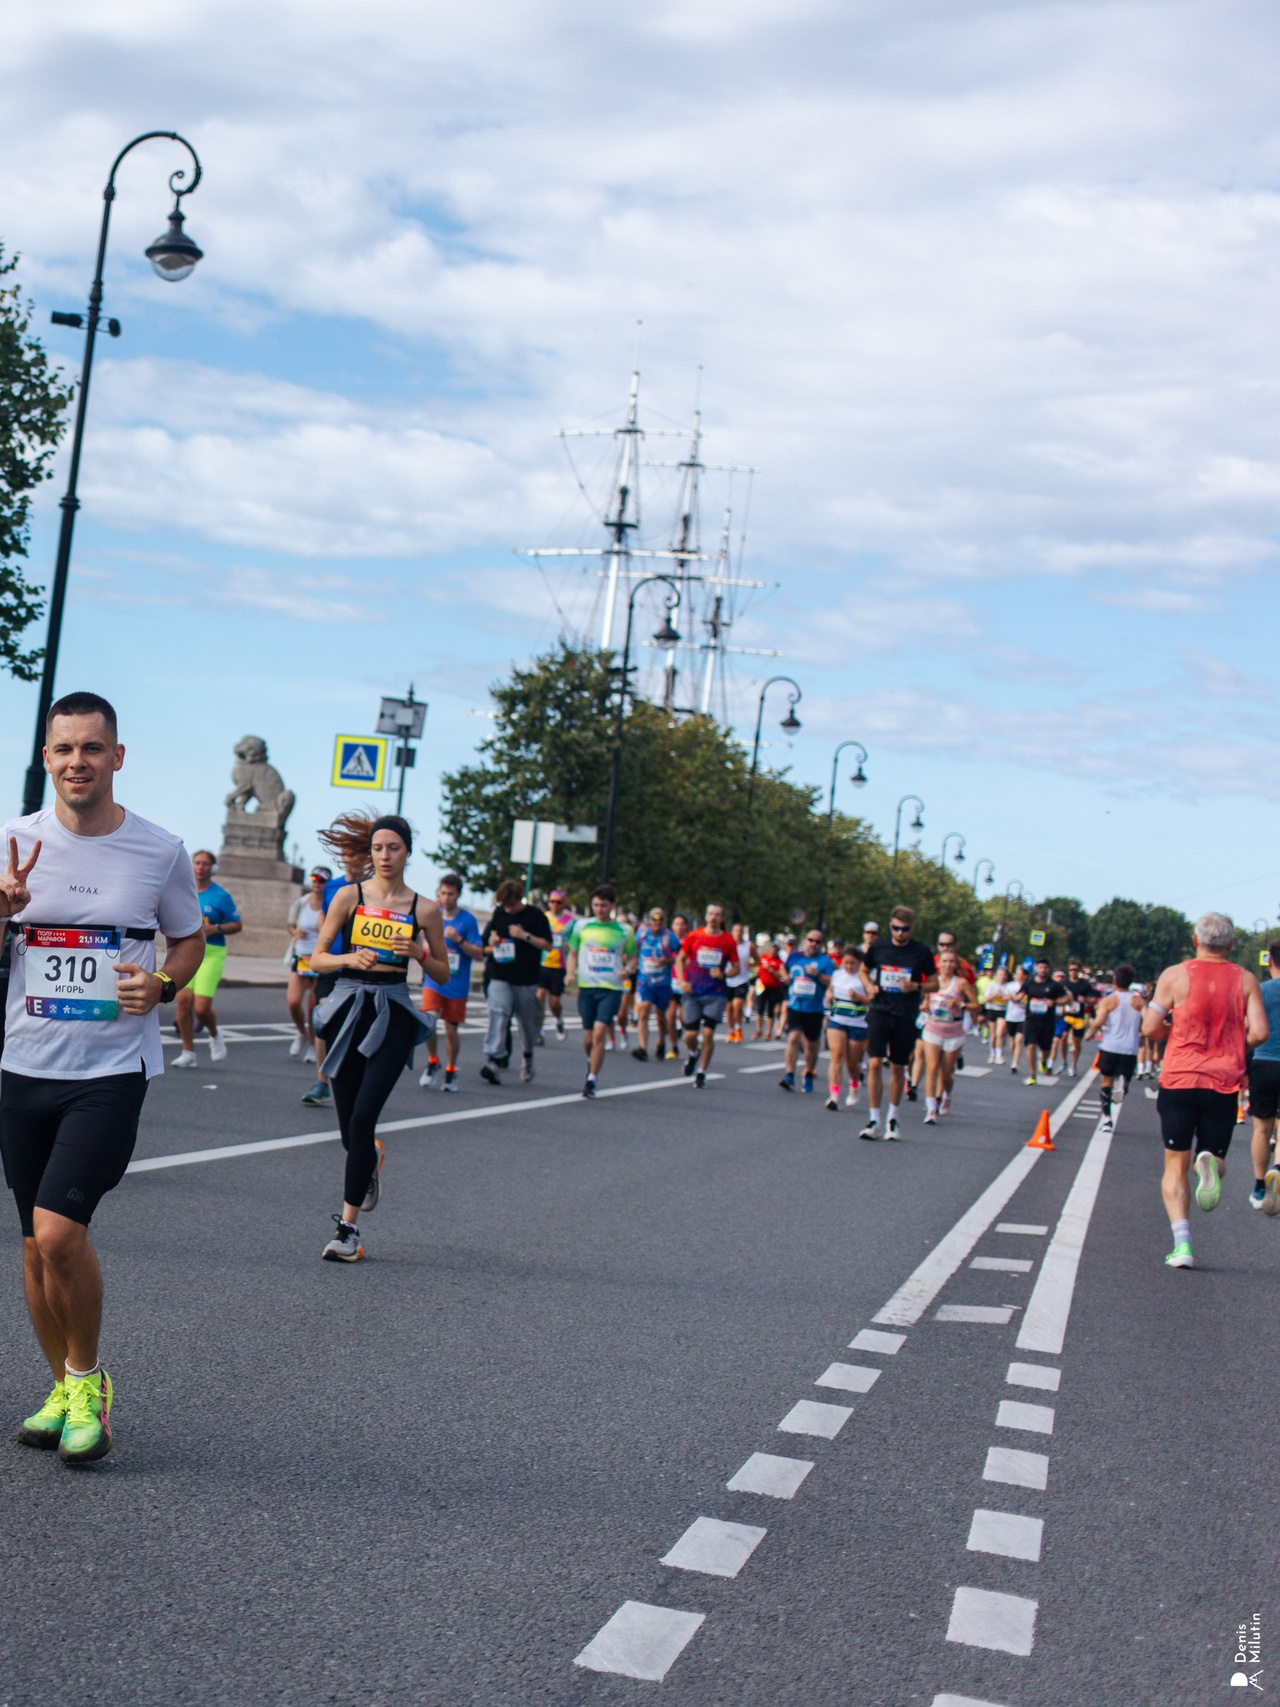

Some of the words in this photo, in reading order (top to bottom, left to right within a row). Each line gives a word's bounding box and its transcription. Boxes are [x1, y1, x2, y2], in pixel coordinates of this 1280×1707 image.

[78, 935, 93, 944] 21,1
[95, 936, 108, 944] КМ
[44, 955, 97, 983] 310
[55, 985, 84, 994] ИГОРЬ
